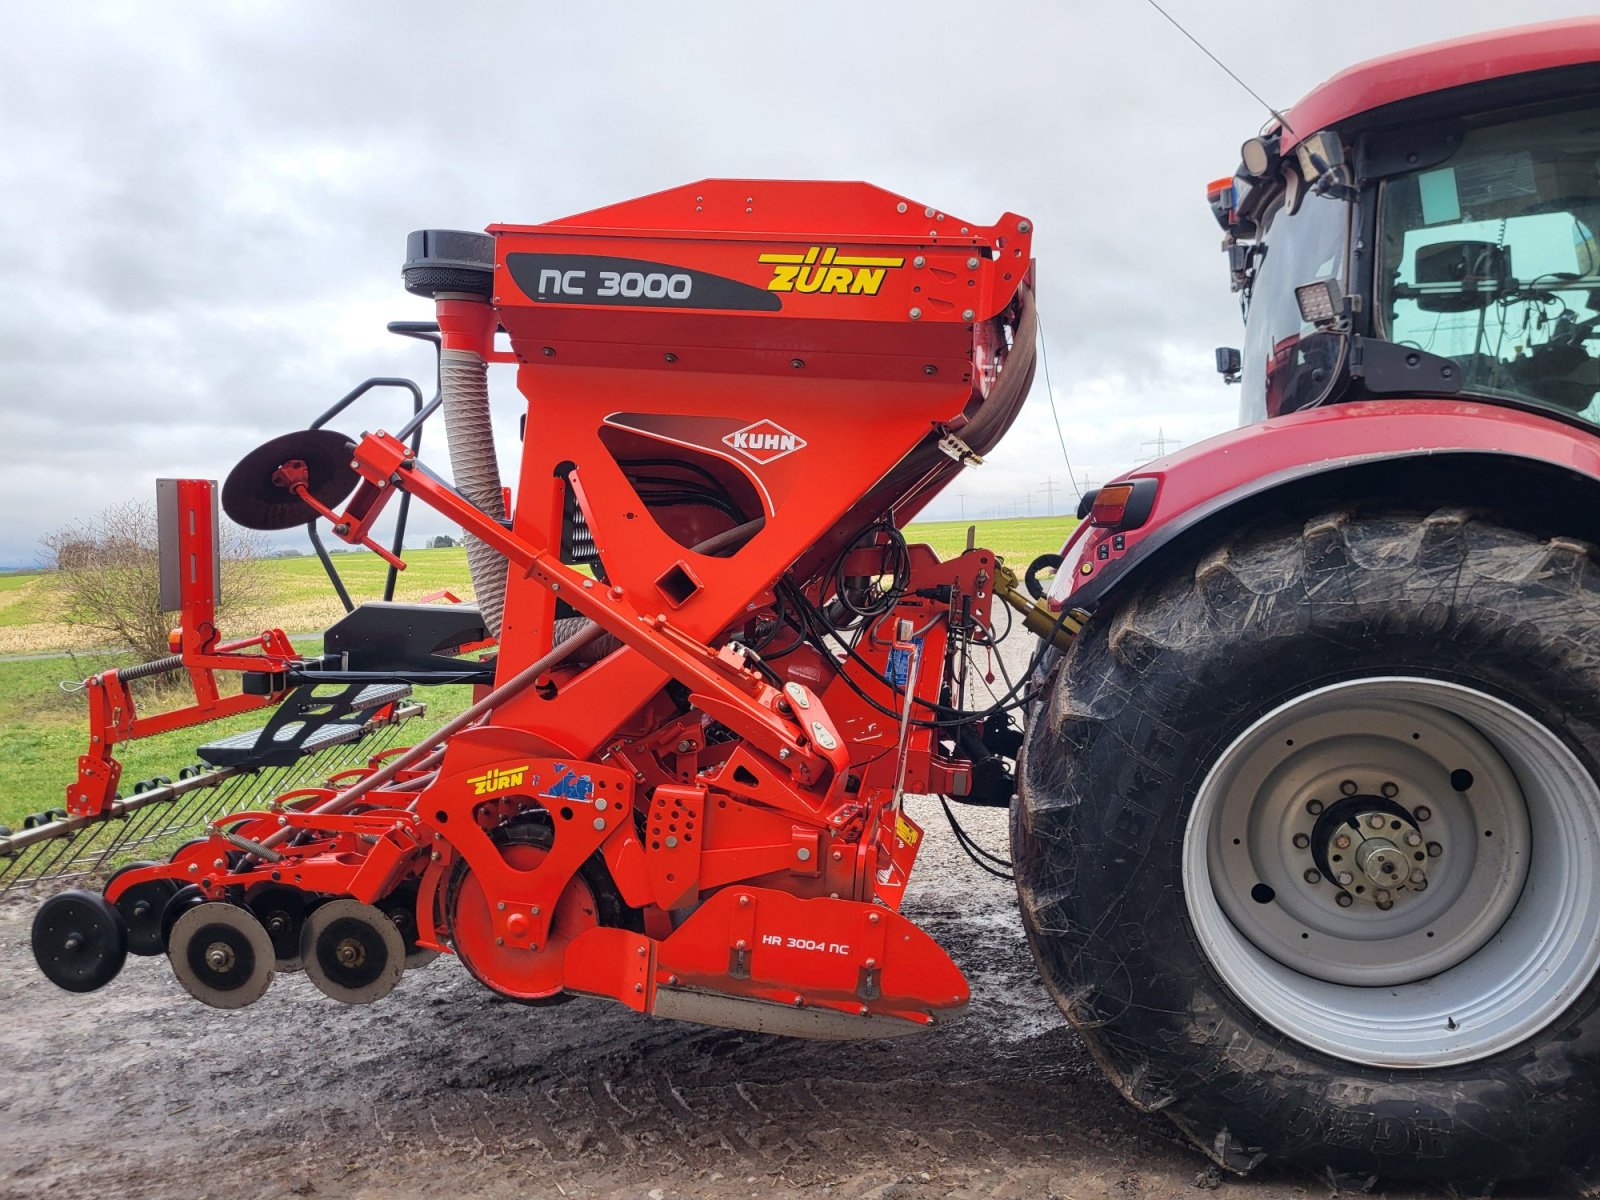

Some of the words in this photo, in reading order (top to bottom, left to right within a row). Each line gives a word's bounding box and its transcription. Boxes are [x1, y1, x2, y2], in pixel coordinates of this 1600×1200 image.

[597, 271, 692, 300] 3000
[759, 246, 904, 296] ZÜRN
[733, 432, 796, 451] KUHN
[466, 765, 530, 796] ZÜRN
[761, 934, 782, 947] HR
[786, 937, 826, 952] 3004
